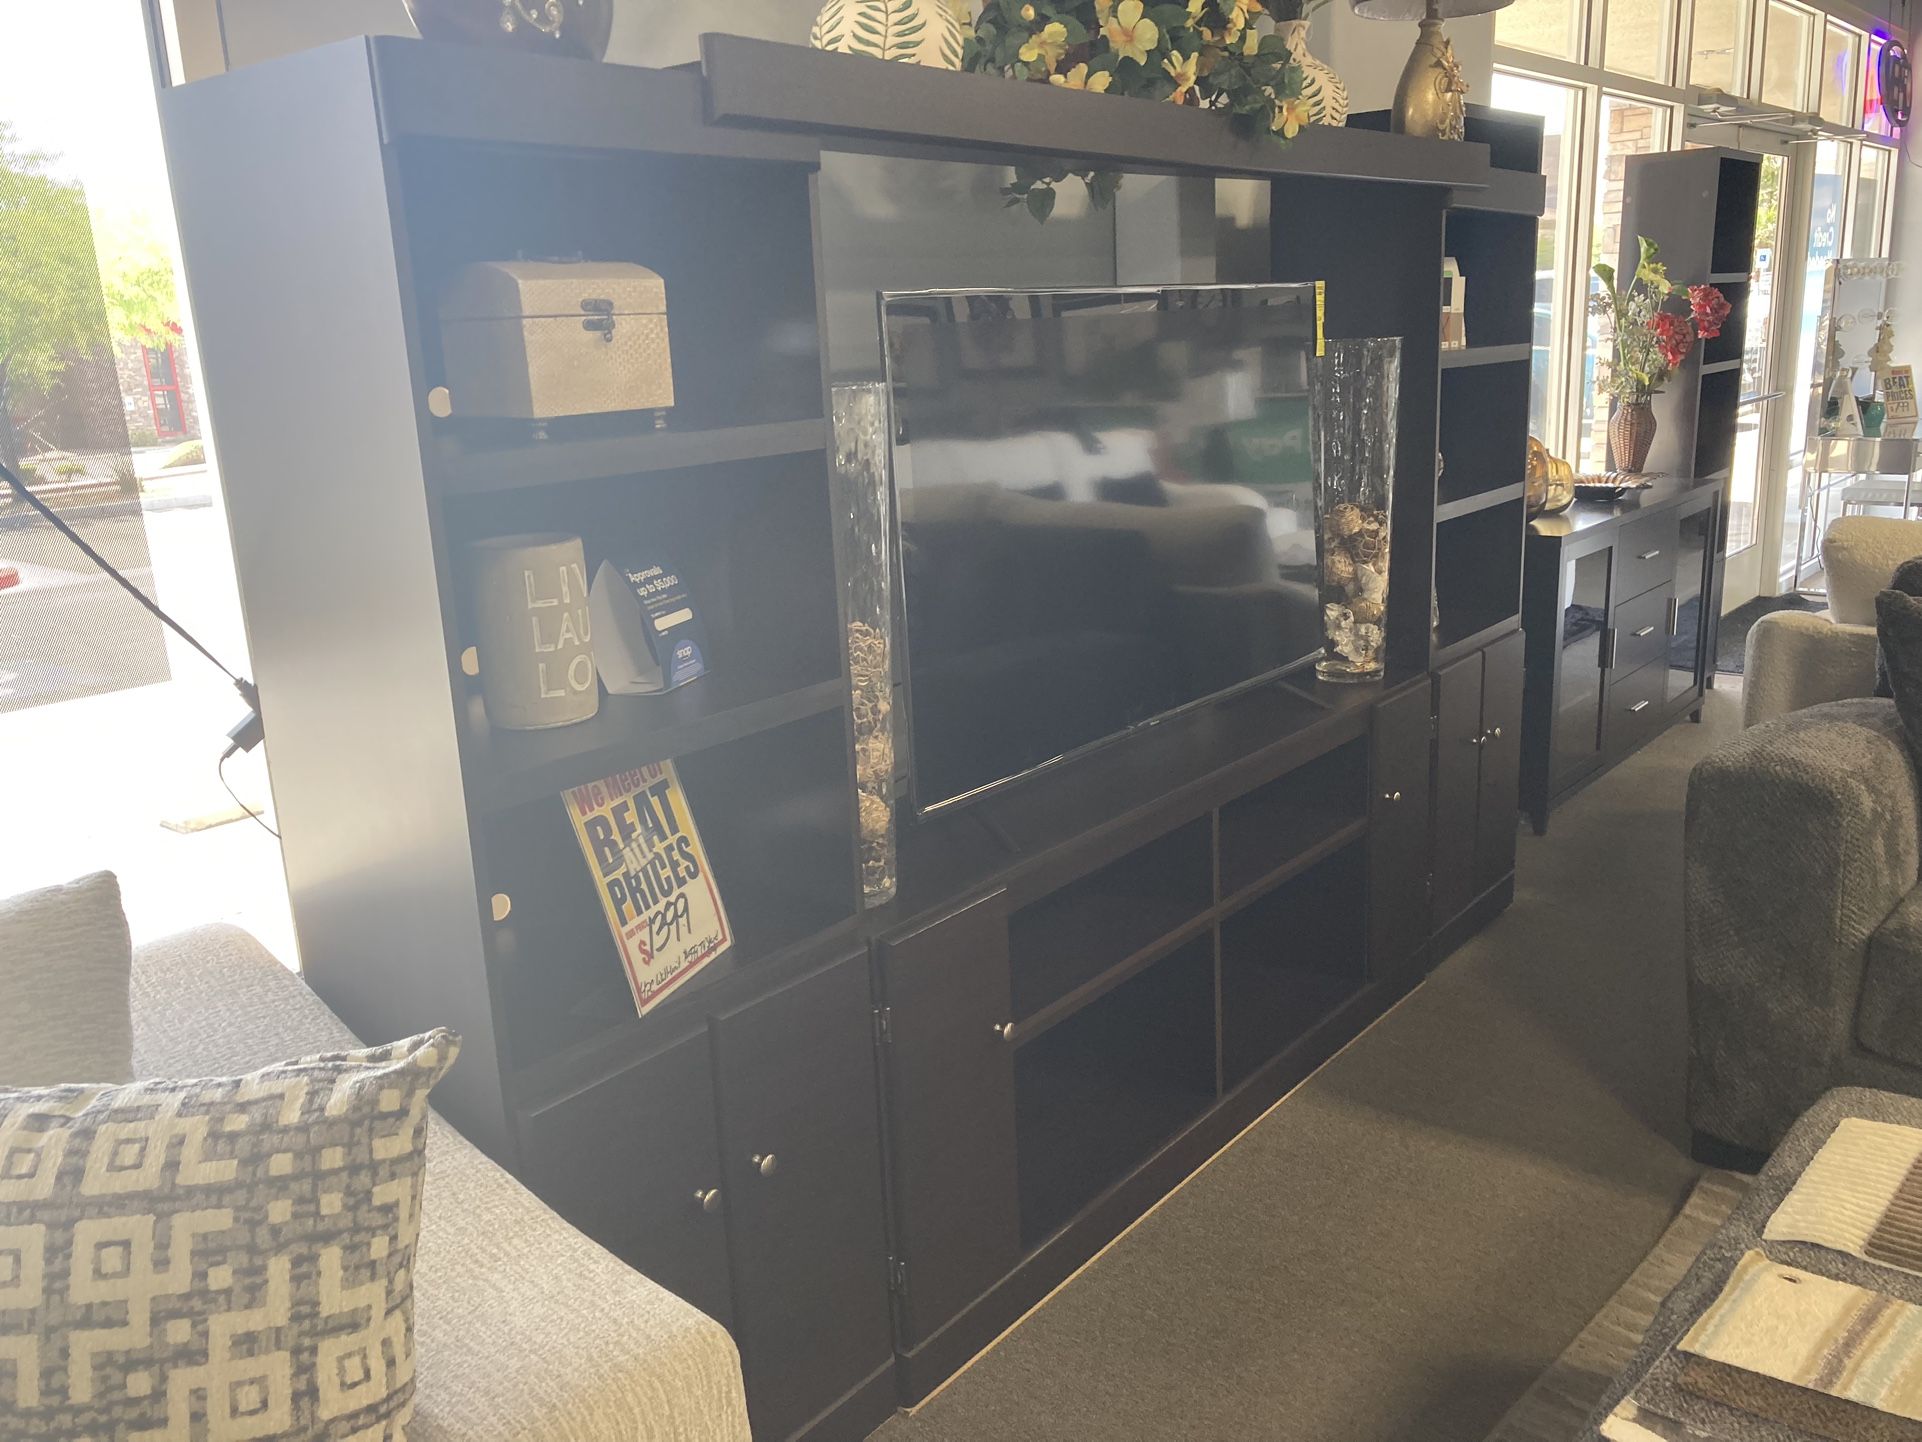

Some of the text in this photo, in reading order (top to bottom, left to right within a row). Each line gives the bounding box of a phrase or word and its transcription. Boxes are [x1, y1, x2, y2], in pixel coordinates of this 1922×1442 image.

[1883, 376, 1910, 390] BEAT
[637, 586, 648, 597] up
[646, 583, 656, 592] to
[538, 652, 595, 698] LO
[571, 784, 605, 816] We
[583, 778, 681, 877] BEAT
[623, 834, 655, 876] ALL
[606, 834, 701, 928] PRICES
